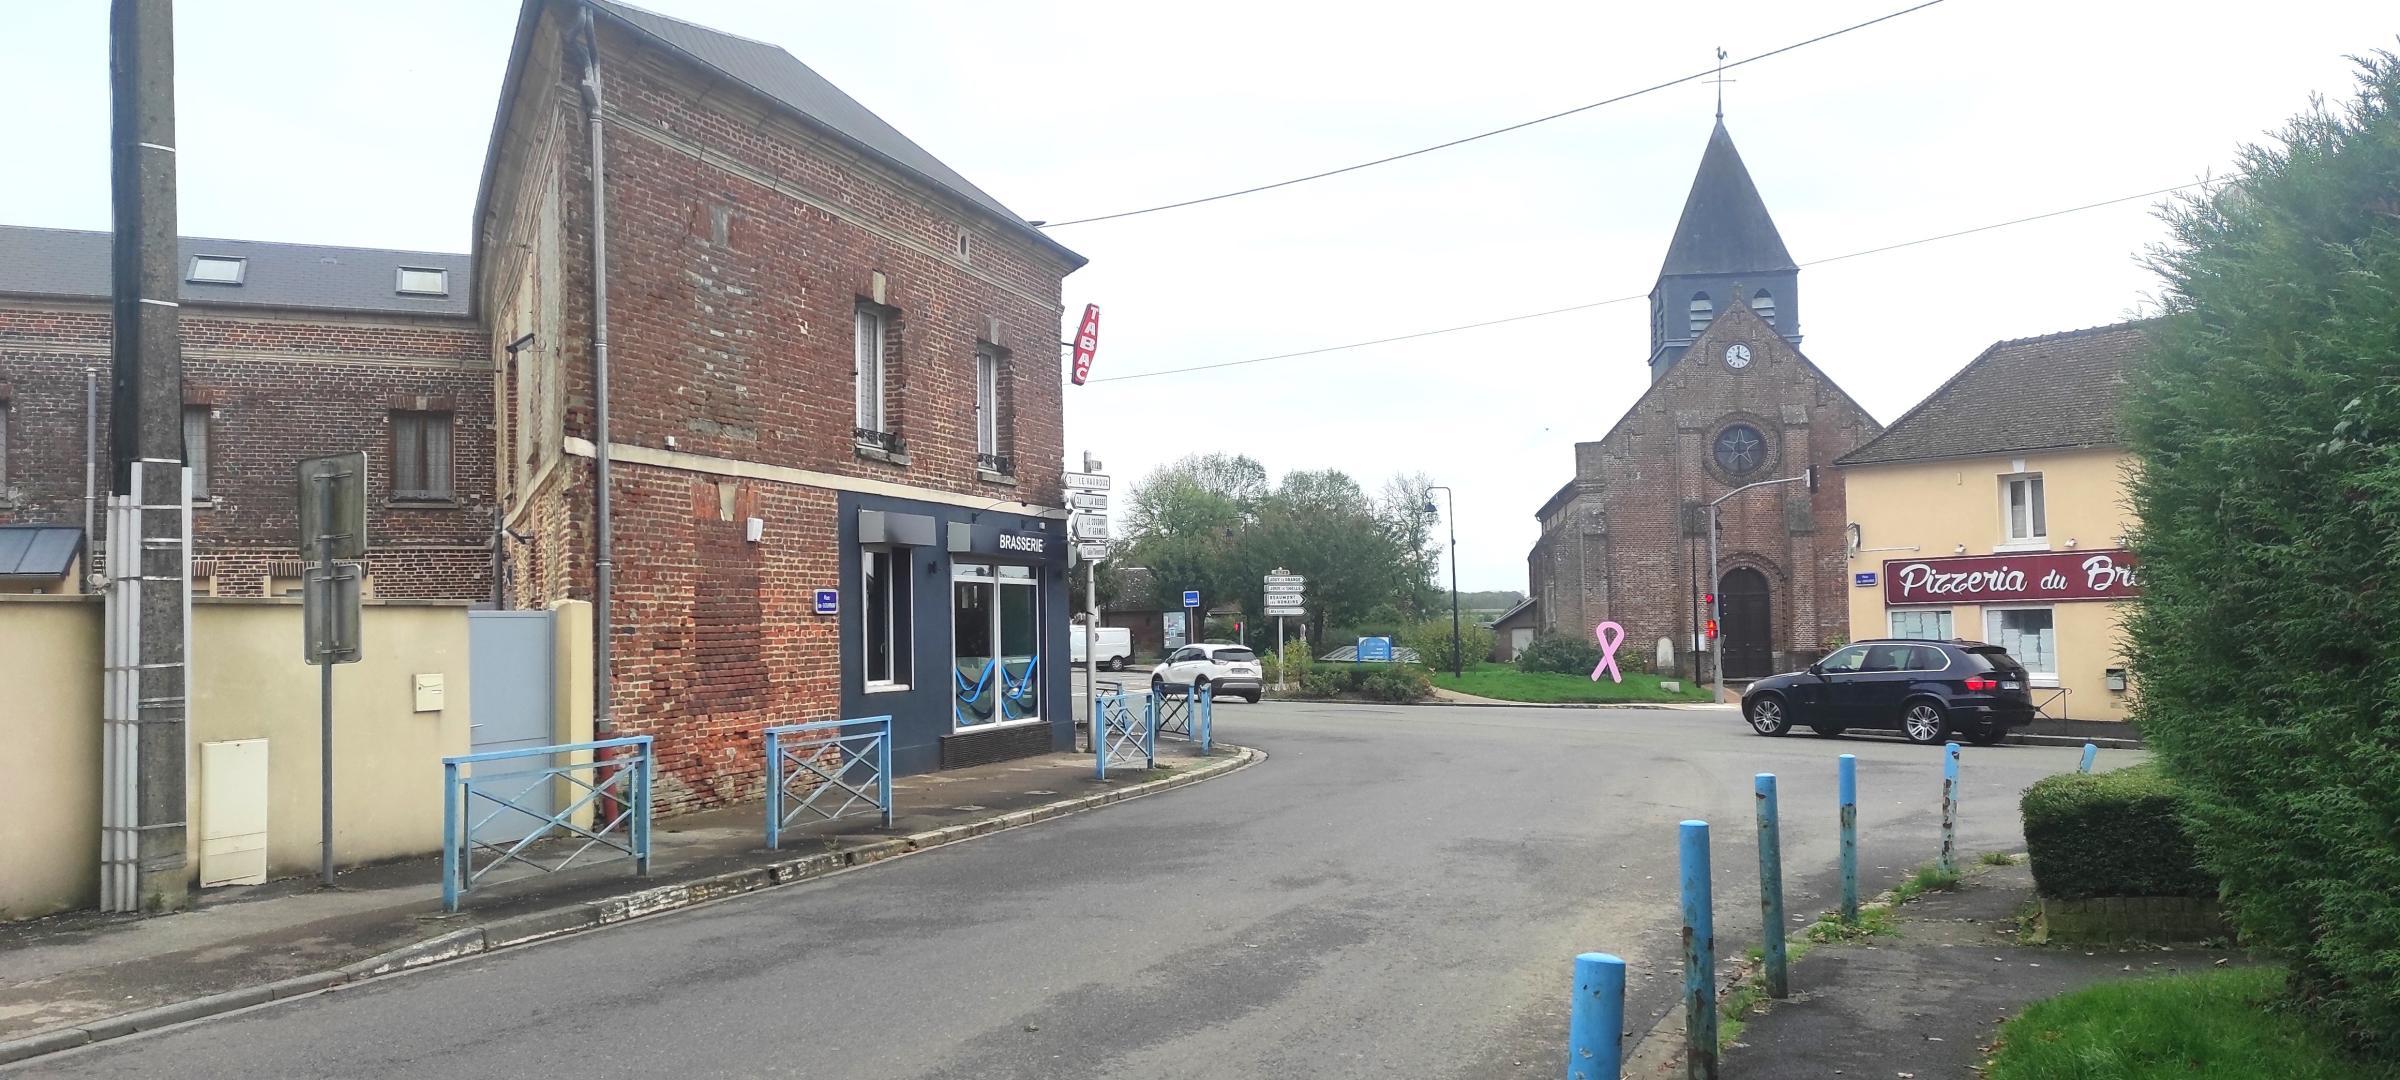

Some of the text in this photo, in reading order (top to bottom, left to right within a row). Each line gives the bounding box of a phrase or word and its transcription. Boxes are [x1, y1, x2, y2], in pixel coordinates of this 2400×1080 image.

[1076, 306, 1099, 380] TABAC
[999, 534, 1044, 553] BRASSERIE
[1899, 563, 2028, 597] Pizzeria
[2040, 569, 2068, 591] du
